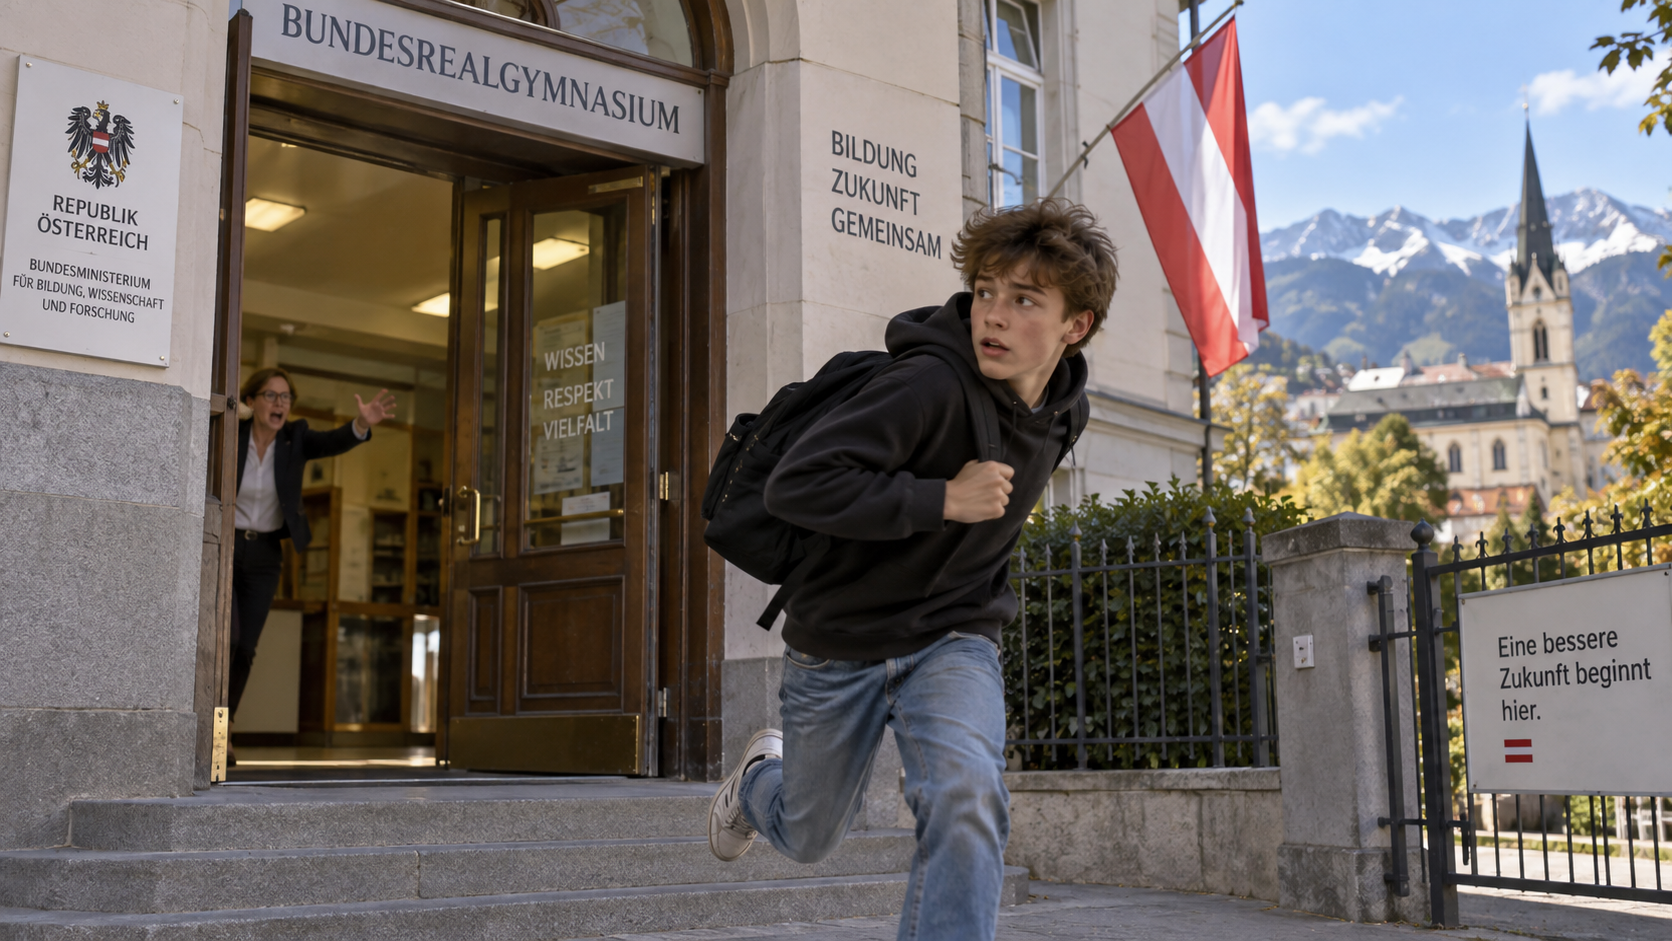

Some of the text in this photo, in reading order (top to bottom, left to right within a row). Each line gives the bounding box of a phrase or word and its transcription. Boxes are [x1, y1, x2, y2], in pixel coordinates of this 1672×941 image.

[281, 3, 680, 134] BUNDESREALGYMNASIUM
[831, 130, 917, 178] BILDUNG
[831, 168, 920, 216] ZUKUNFT
[53, 194, 139, 227] REPUBLIK
[37, 212, 148, 251] ÖSTERREICH
[831, 207, 941, 259] GEMEINSAM
[29, 258, 151, 290] BUNDESMINISTERIUM
[42, 298, 135, 324] UND FORSCHUNG
[88, 286, 165, 311] WISSENSCHAFT
[544, 341, 605, 371] WISSEN
[543, 378, 614, 410] RESPEKT
[543, 410, 614, 441] VIELFALT
[1498, 630, 1618, 658] Eine bessere
[1499, 657, 1652, 690] Zukunft beginnt
[1501, 699, 1541, 721] hier.
